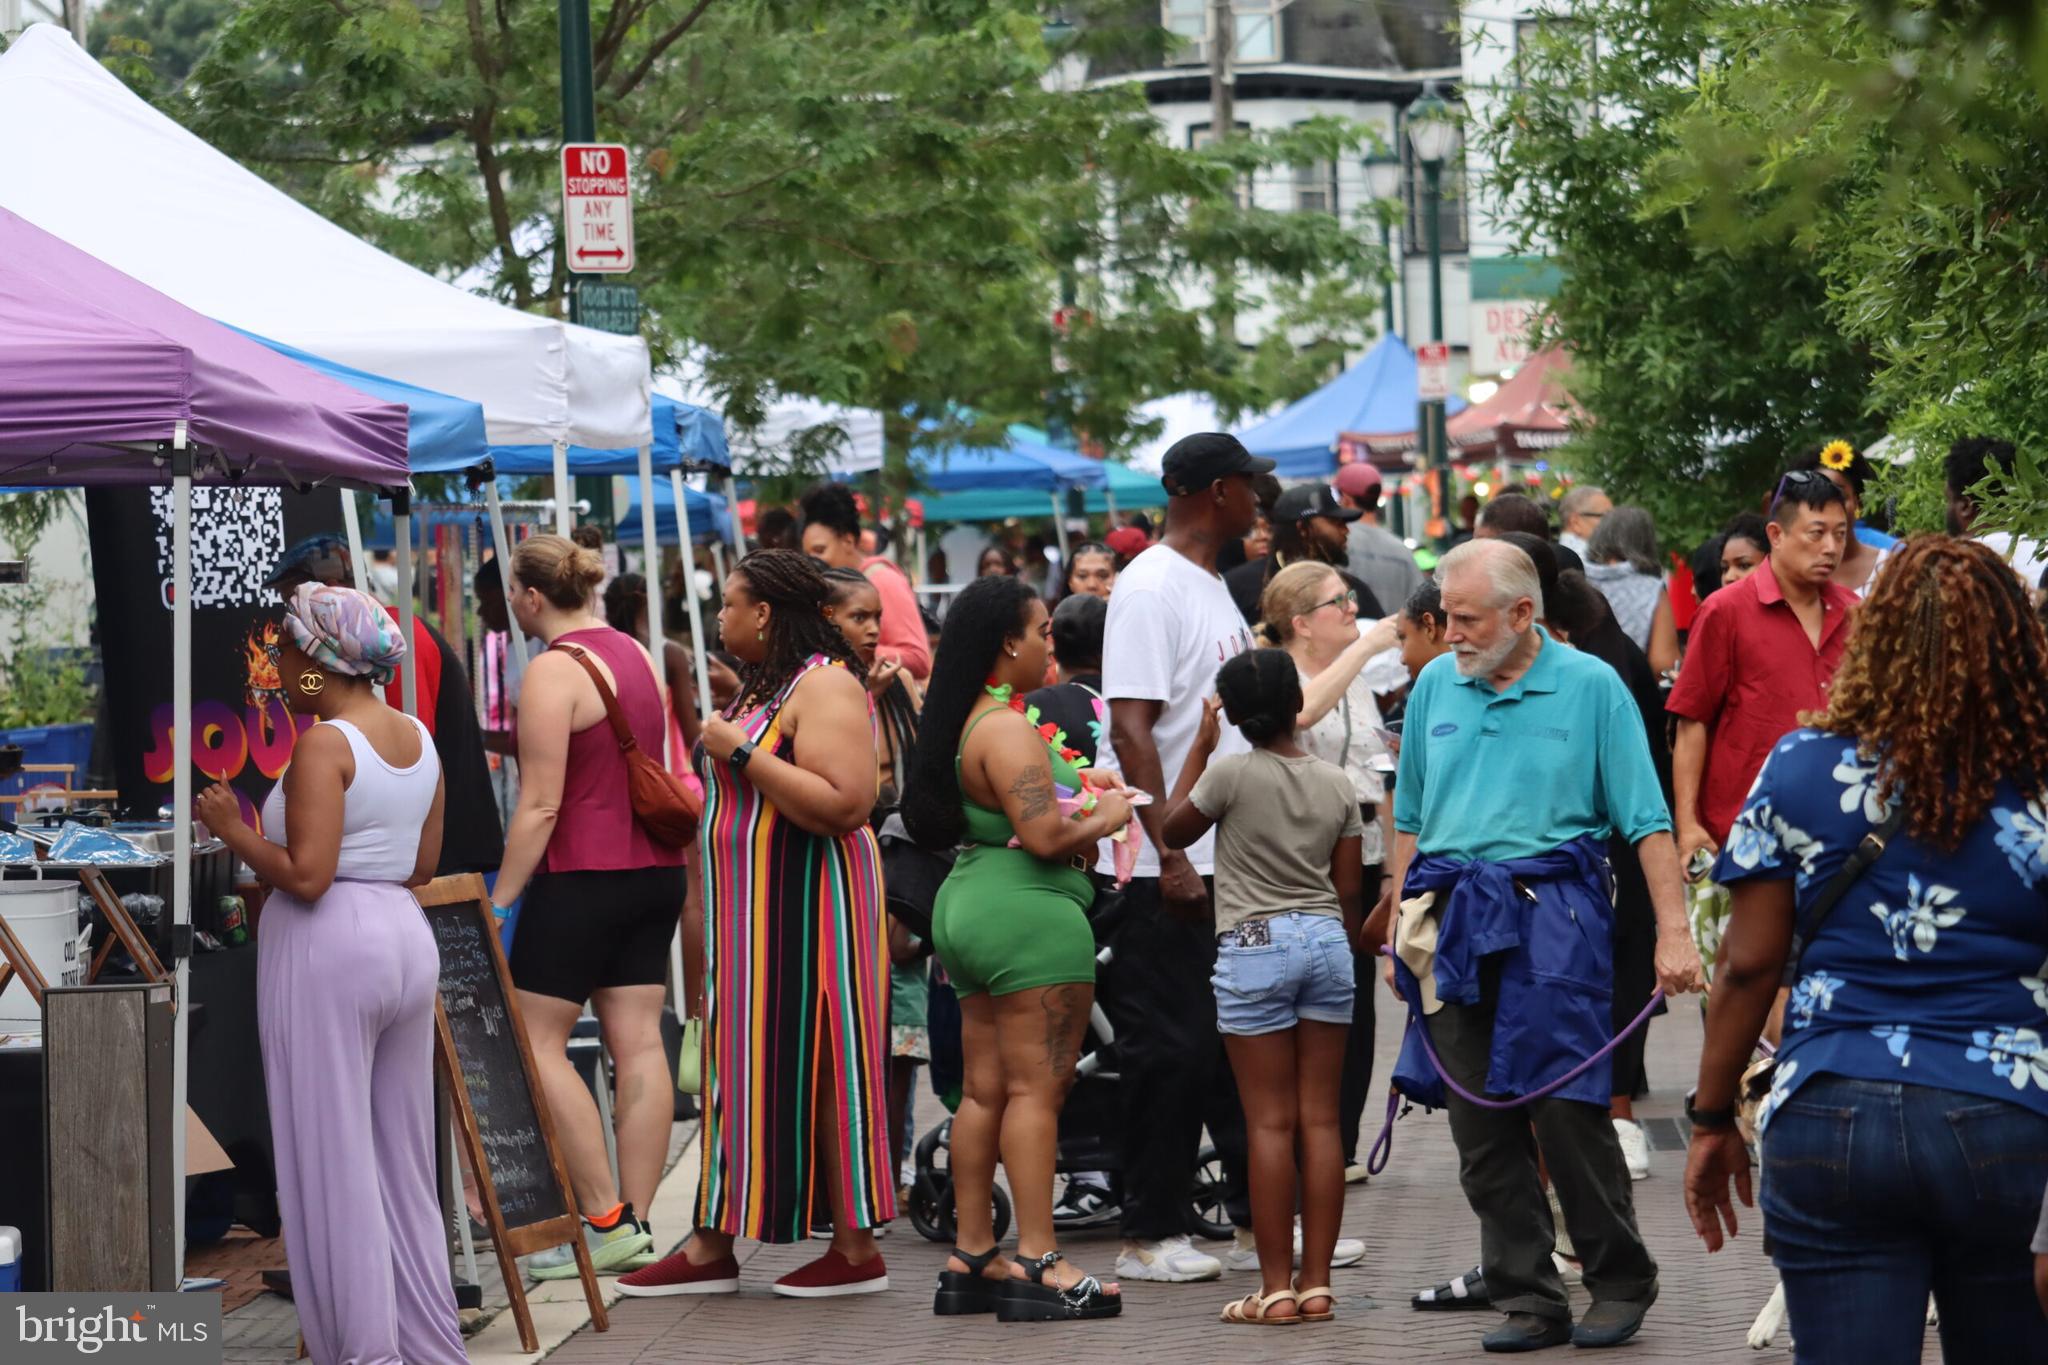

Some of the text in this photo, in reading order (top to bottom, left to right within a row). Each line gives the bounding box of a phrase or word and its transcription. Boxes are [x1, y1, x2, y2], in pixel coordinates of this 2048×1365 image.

[580, 150, 612, 175] NO
[568, 178, 626, 194] STOPPING
[583, 200, 612, 218] ANY
[583, 223, 615, 241] TIME
